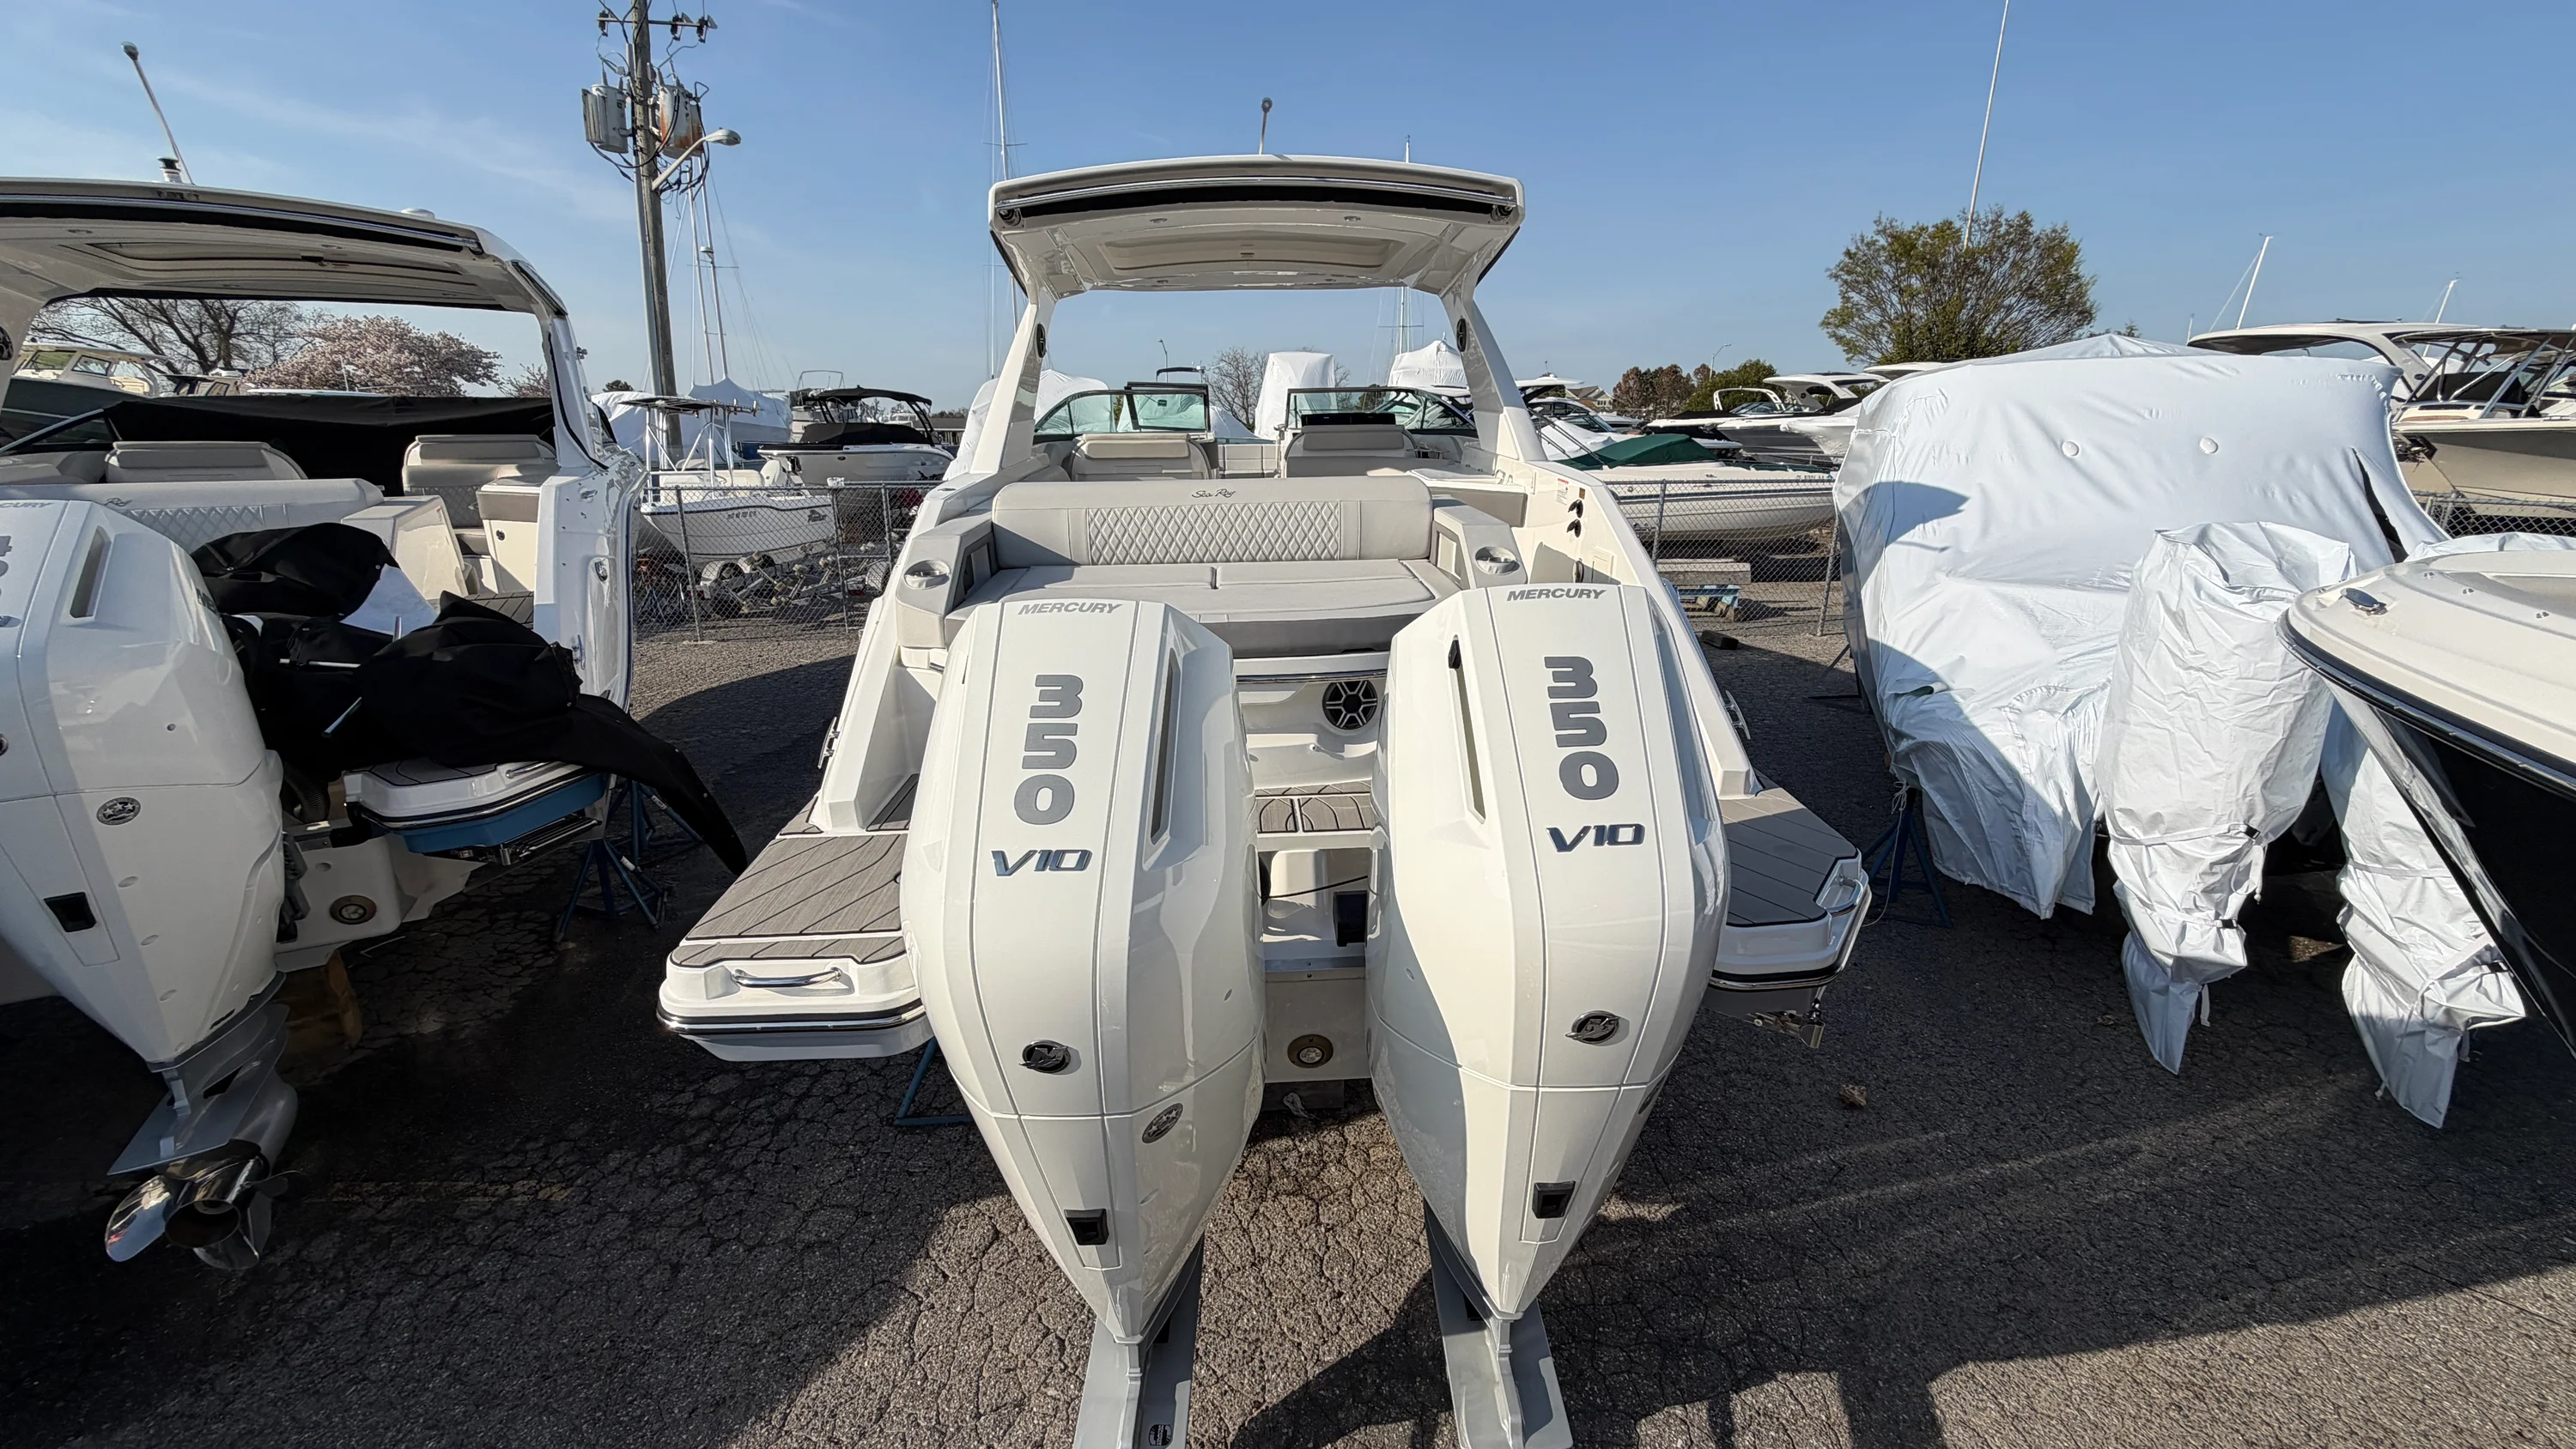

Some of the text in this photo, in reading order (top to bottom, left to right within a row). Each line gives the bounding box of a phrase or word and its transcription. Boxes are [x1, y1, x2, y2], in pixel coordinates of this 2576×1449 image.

[1215, 488, 1236, 498] Ray
[1507, 588, 1607, 601] MERCURY
[1018, 602, 1123, 615] MERCURY
[1544, 657, 1619, 800] 350
[1014, 675, 1084, 825] 350
[1546, 823, 1645, 852] V10
[991, 849, 1092, 876] V10
